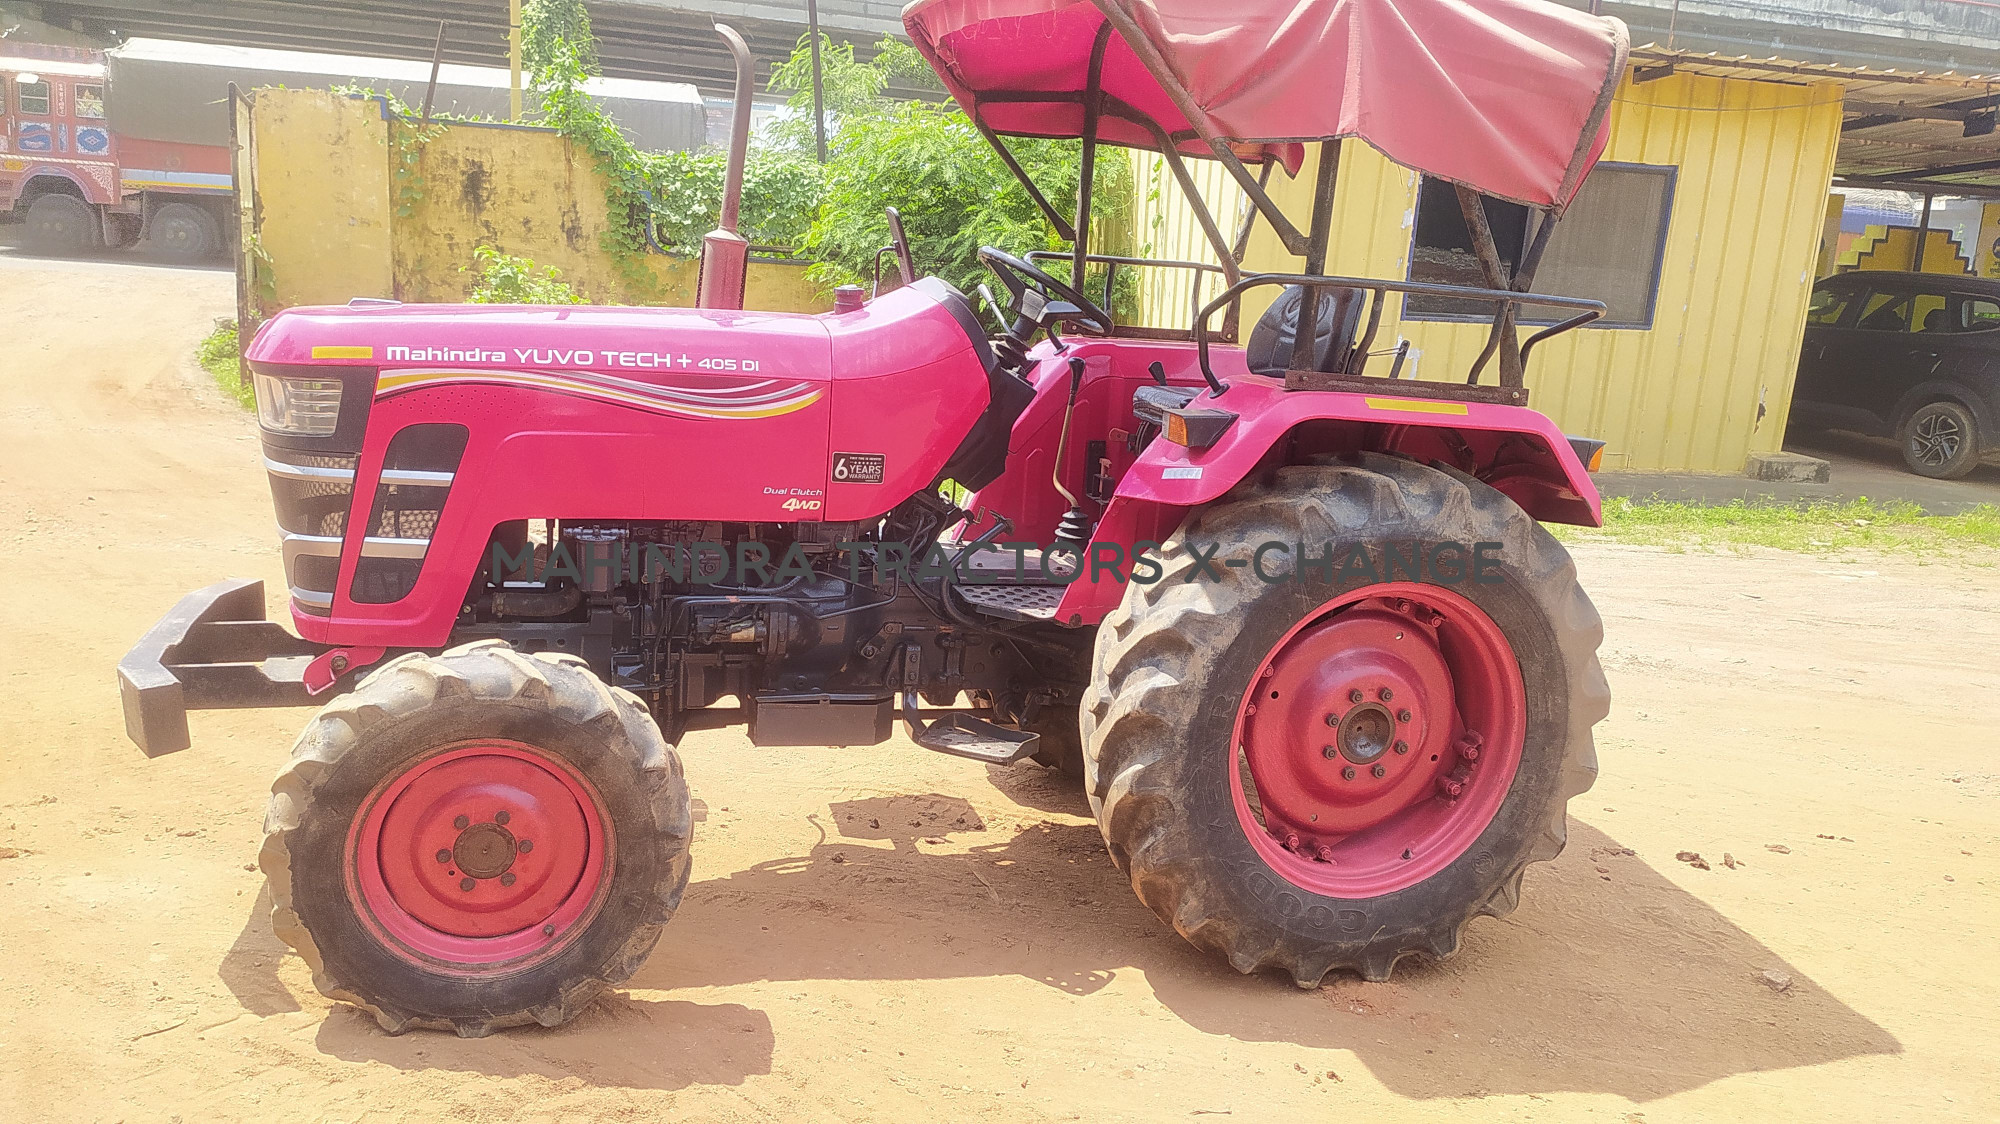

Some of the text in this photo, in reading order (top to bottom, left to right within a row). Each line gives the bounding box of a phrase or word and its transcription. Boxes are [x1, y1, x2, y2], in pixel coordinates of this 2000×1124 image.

[386, 346, 506, 362] Mahindra
[513, 348, 594, 365] YUVO
[600, 351, 671, 368] TECH
[698, 358, 737, 370] 405
[742, 360, 759, 372] DI
[834, 458, 848, 480] 6
[763, 487, 823, 496] Dual Clutch
[781, 498, 821, 512] 4WD
